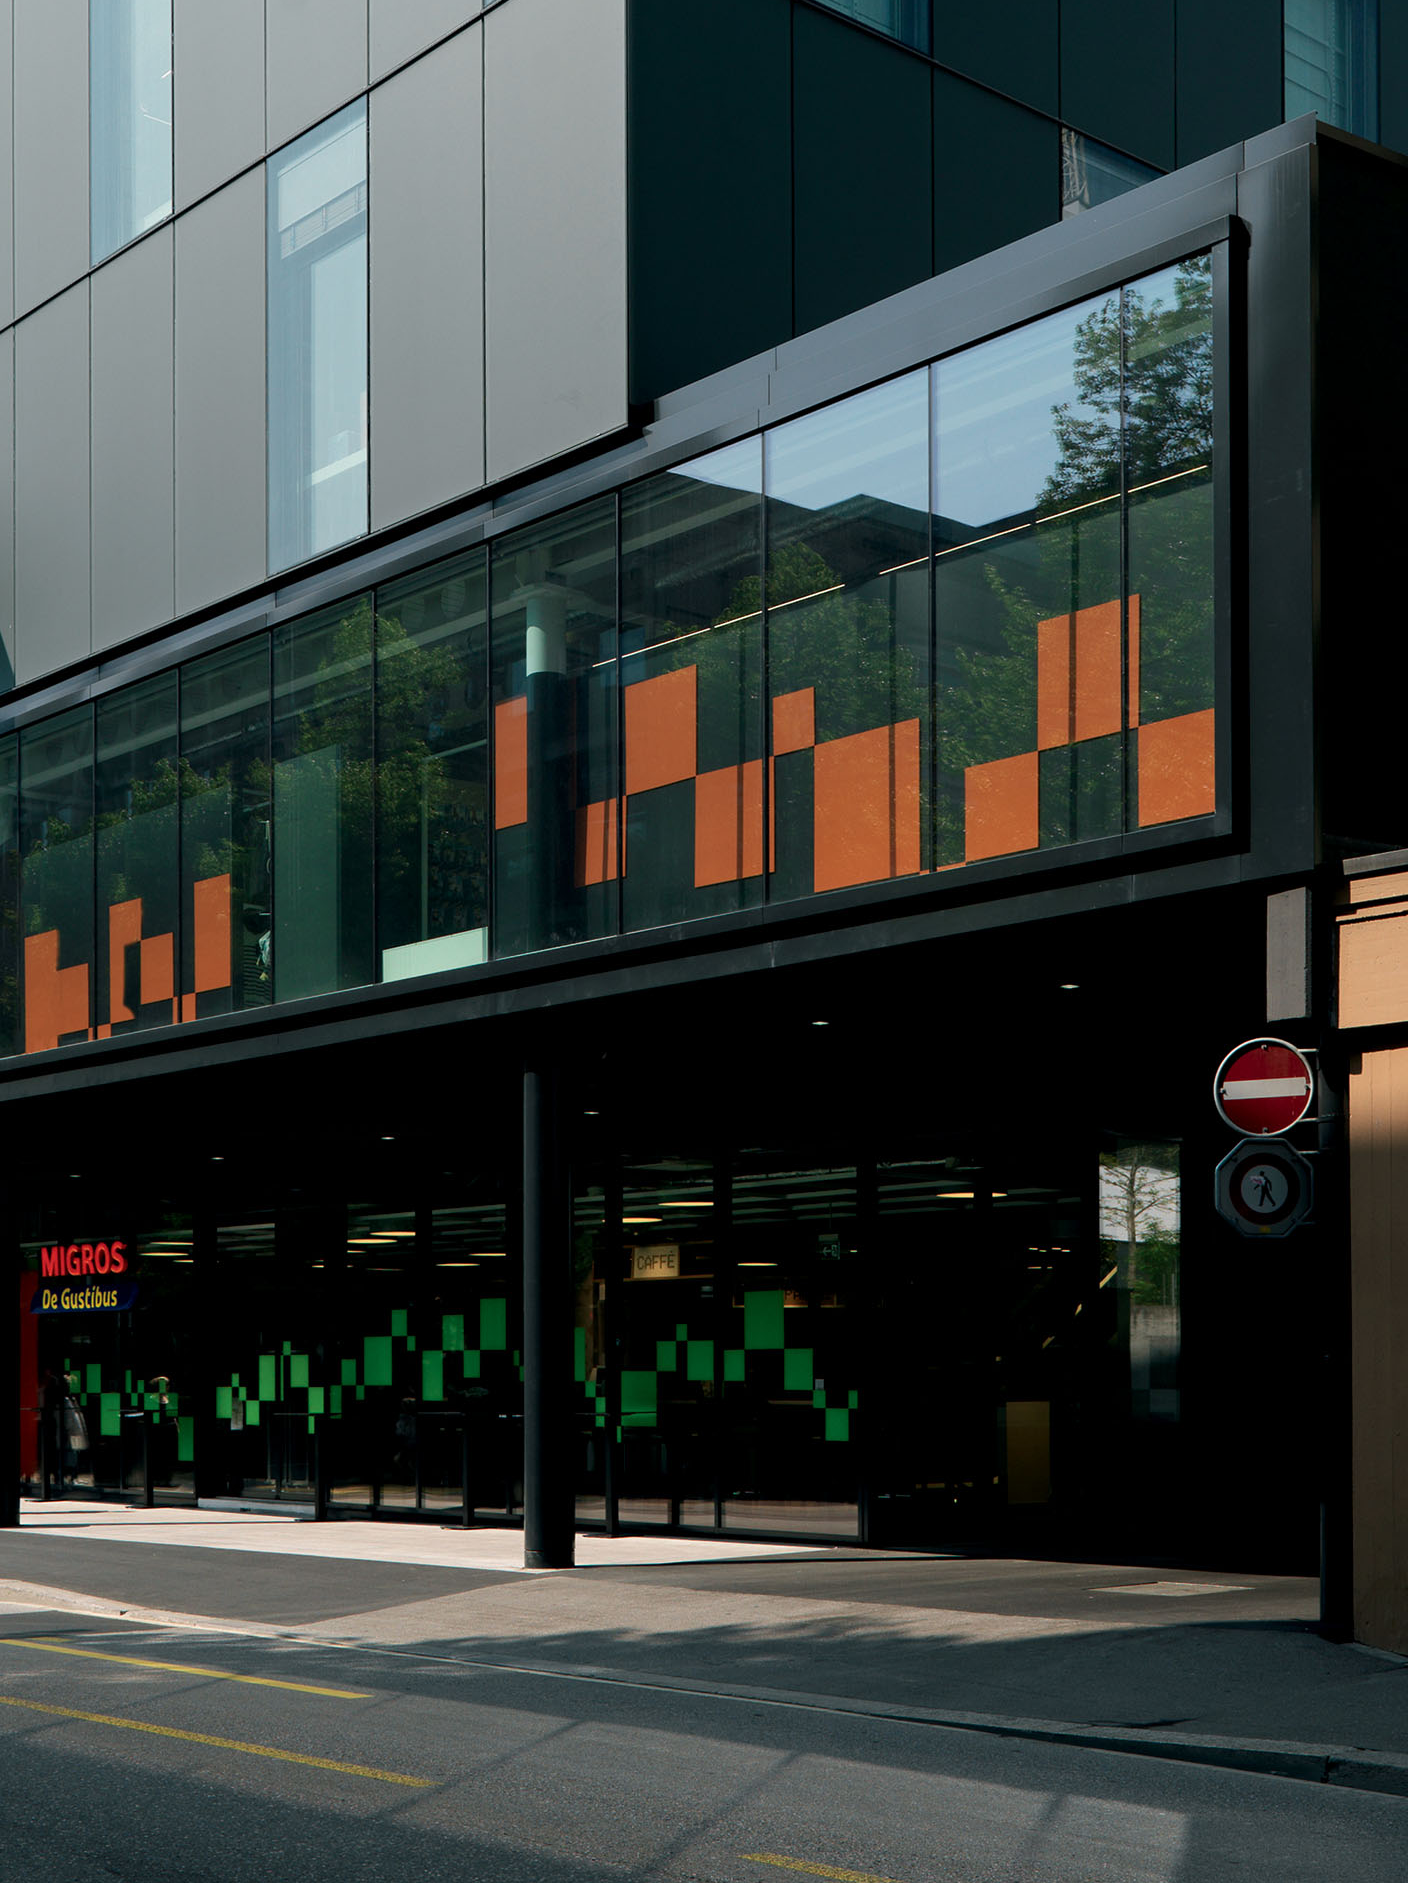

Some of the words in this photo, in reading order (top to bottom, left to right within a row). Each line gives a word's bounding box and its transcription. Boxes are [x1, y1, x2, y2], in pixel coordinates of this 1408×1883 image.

[41, 1241, 127, 1277] MIGROS
[42, 1289, 58, 1309] De
[61, 1286, 117, 1309] Gustibus
